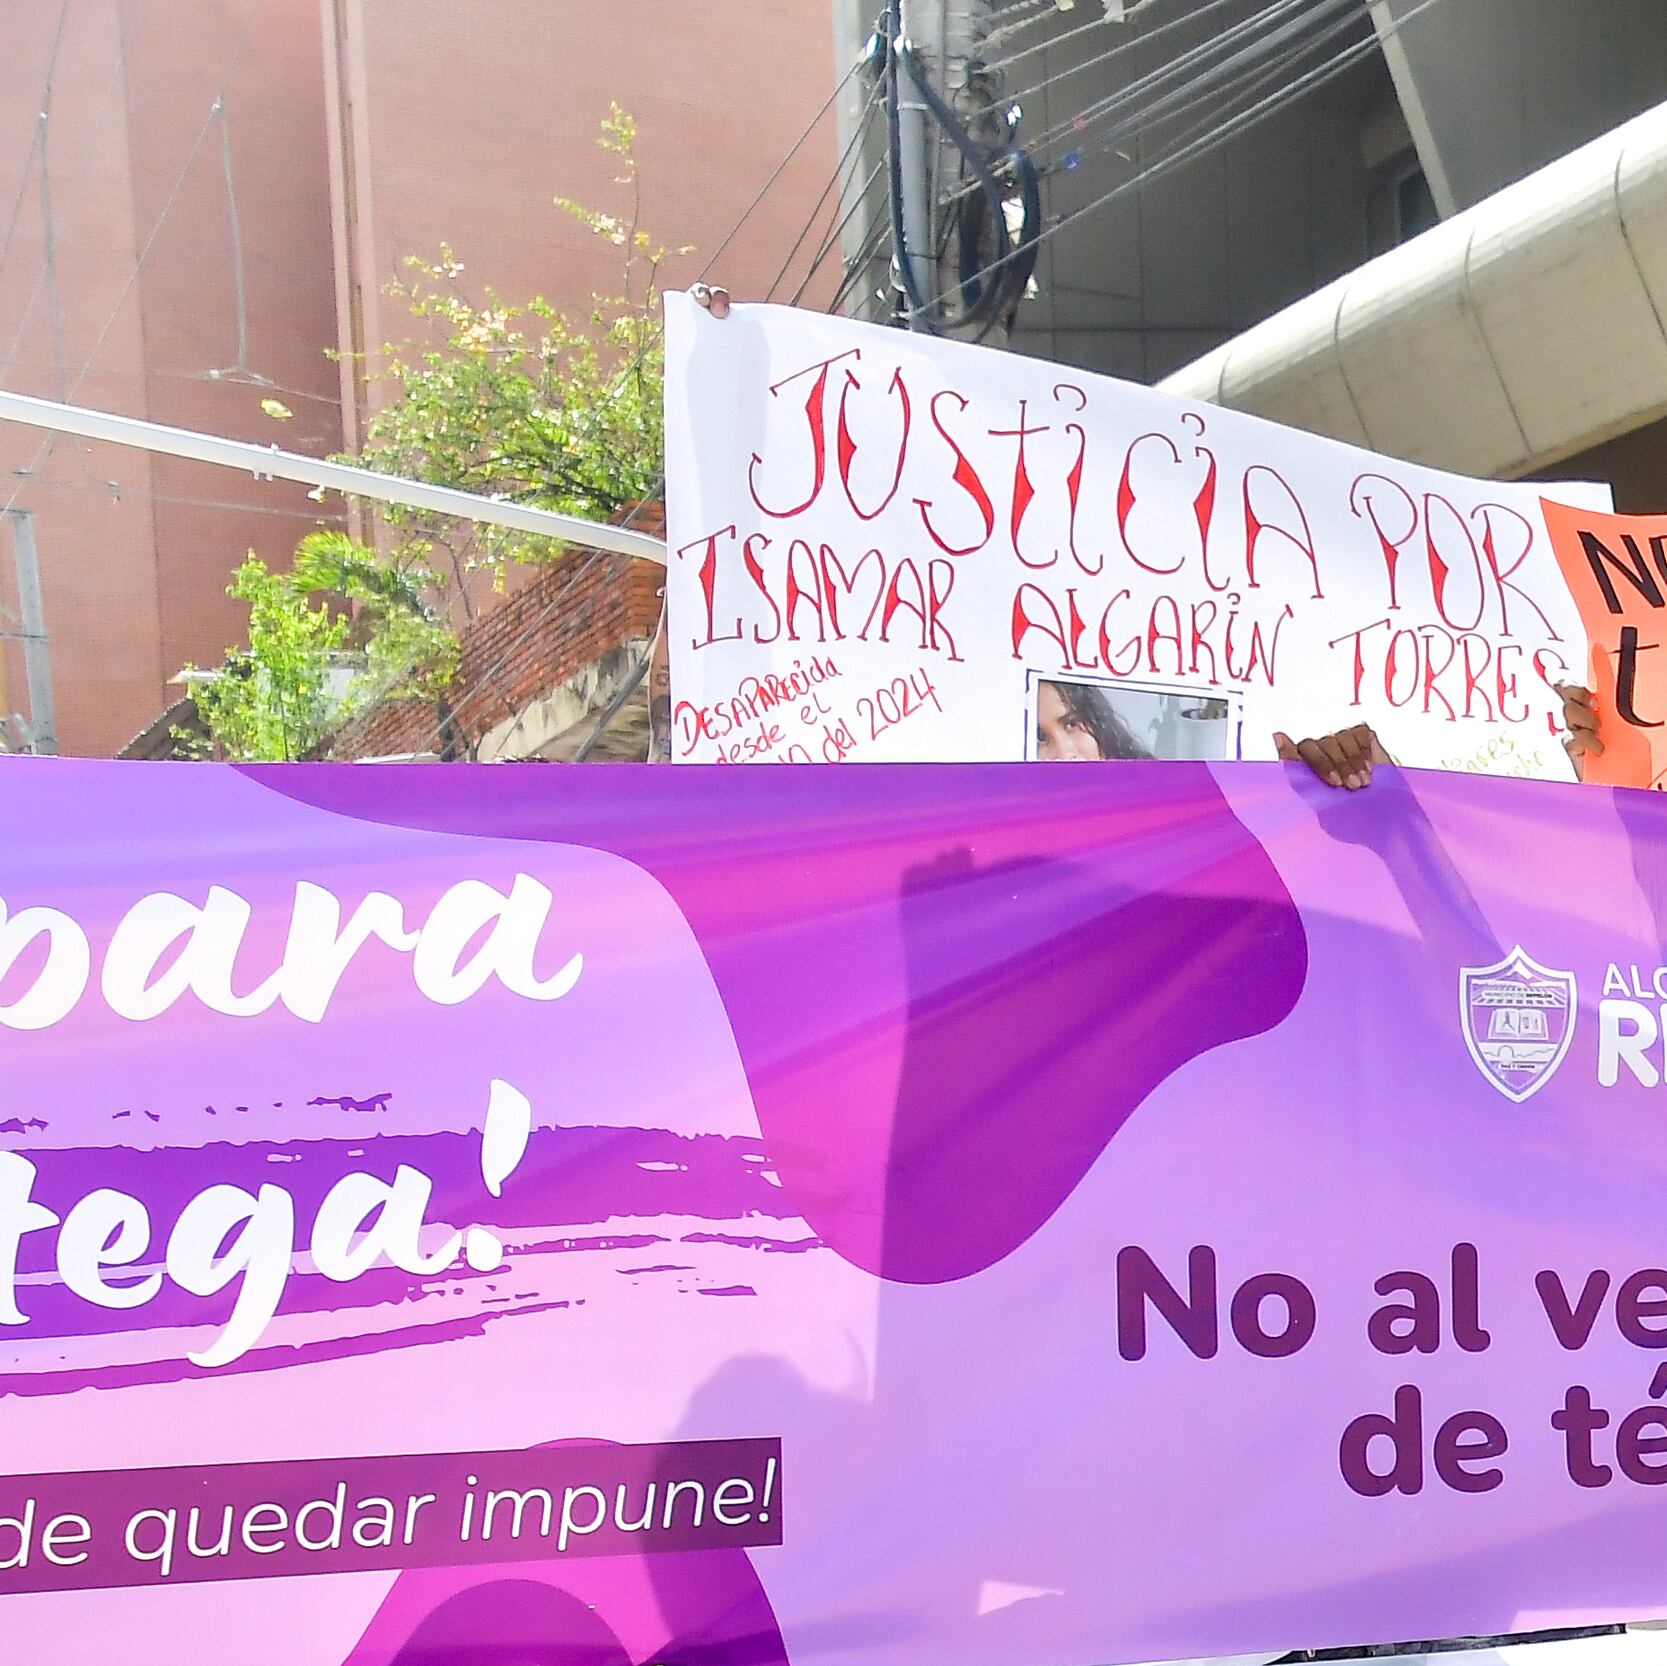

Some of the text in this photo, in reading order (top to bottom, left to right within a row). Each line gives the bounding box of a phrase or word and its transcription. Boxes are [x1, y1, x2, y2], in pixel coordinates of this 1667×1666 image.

[676, 523, 966, 662] ISAMAR
[1350, 471, 1561, 642] POR
[856, 667, 943, 742] 2024
[1116, 1243, 1318, 1362] No
[1366, 1242, 1492, 1356] al
[1339, 1382, 1506, 1498] de
[124, 1481, 437, 1577] quedar
[460, 1456, 778, 1552] impune!
